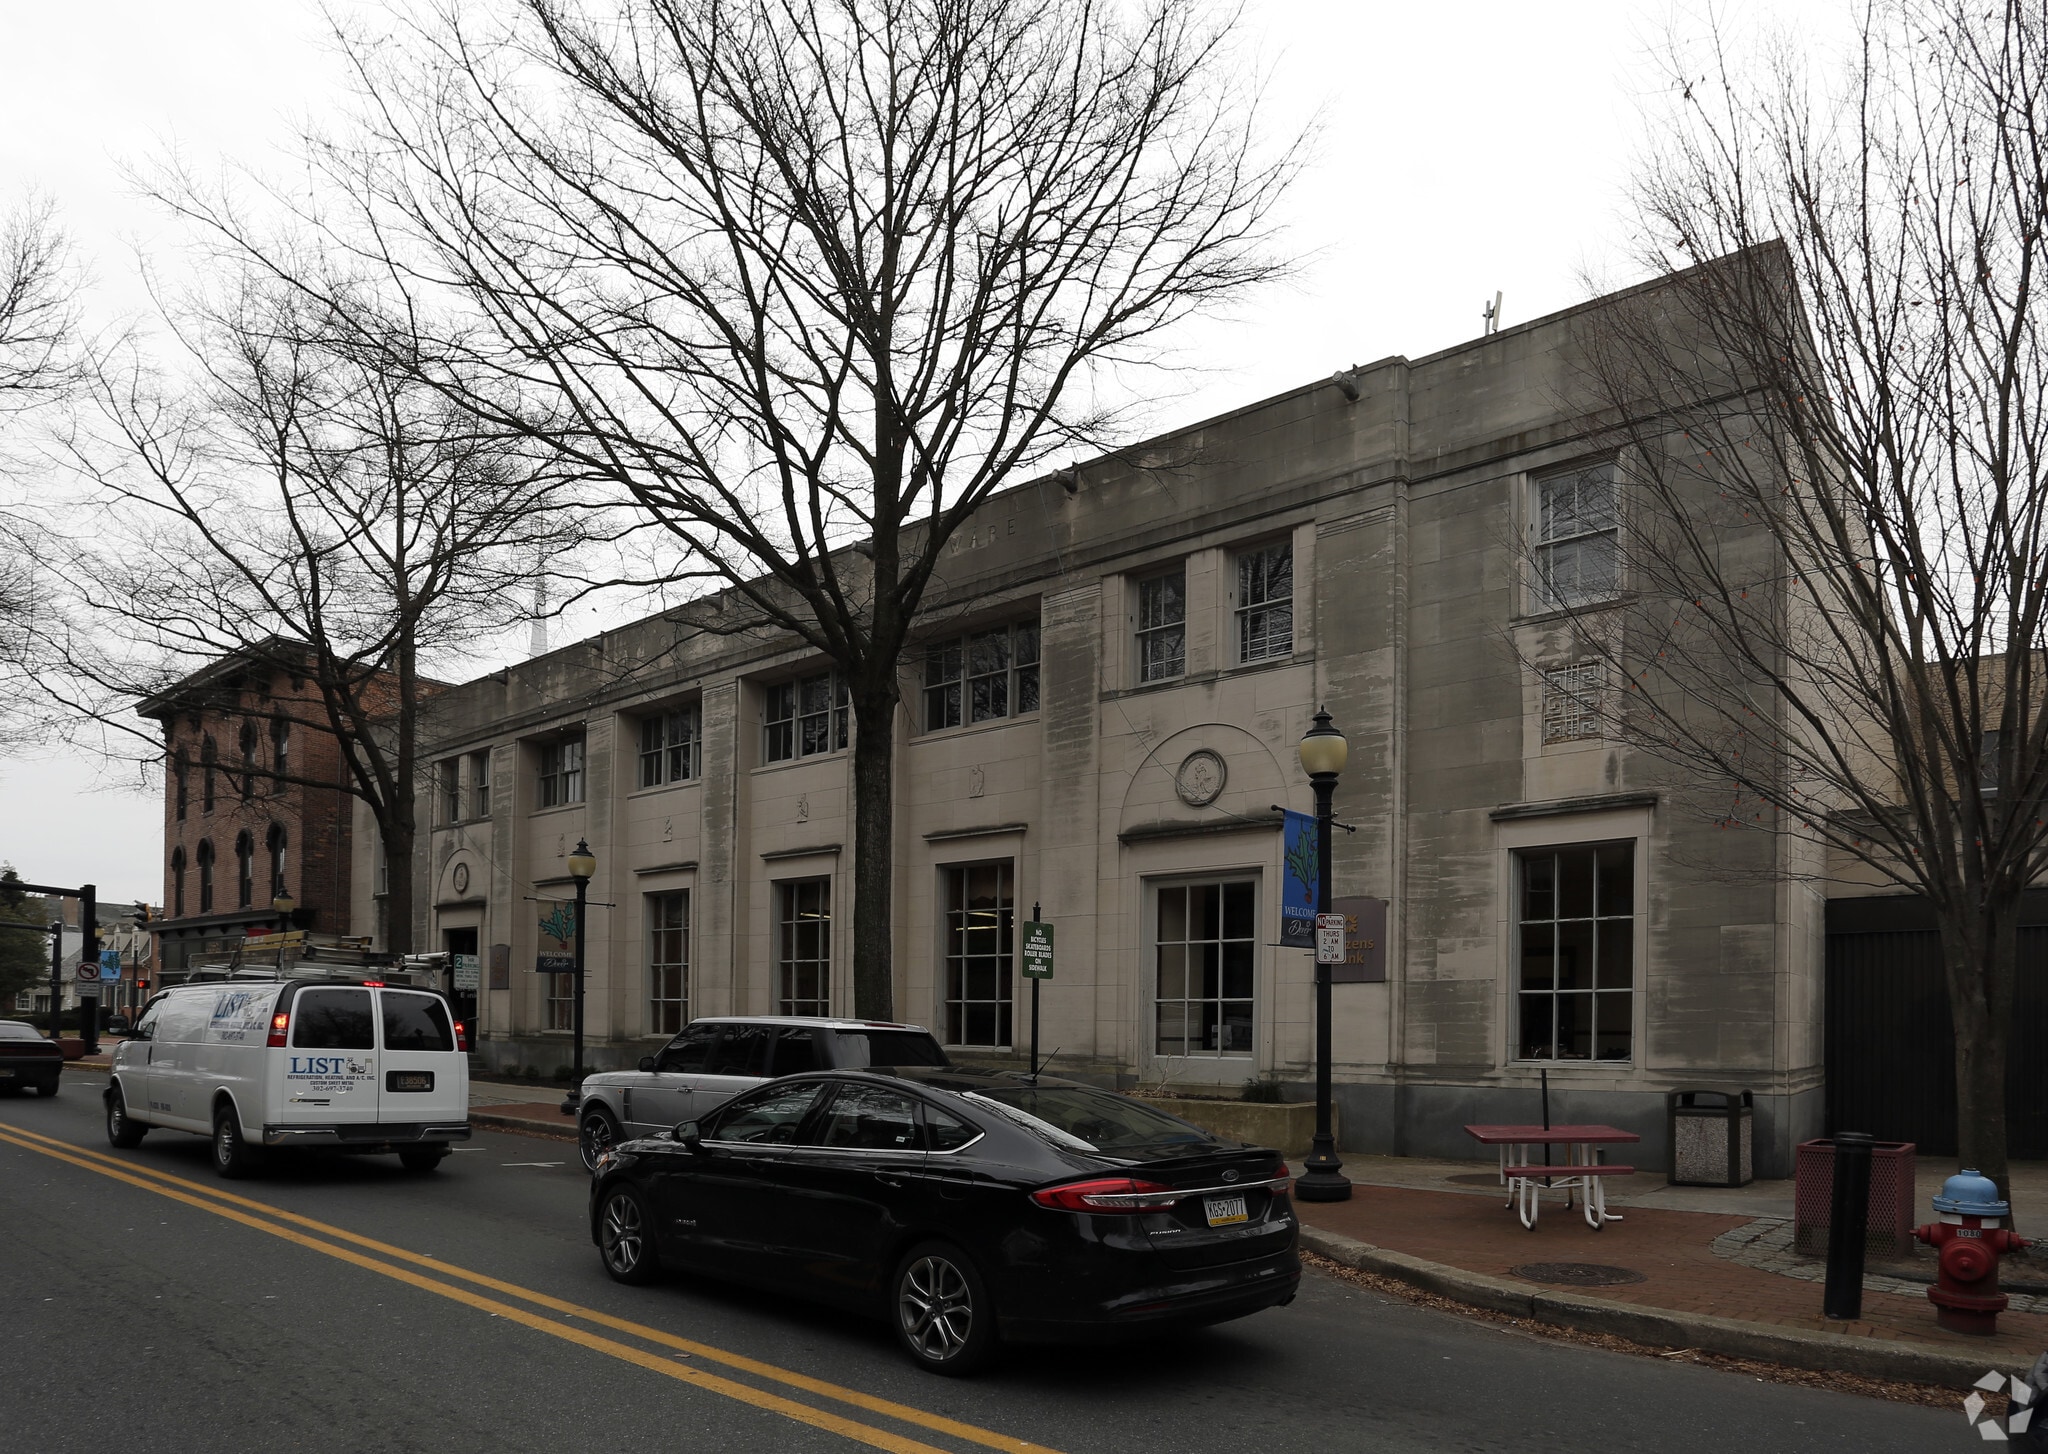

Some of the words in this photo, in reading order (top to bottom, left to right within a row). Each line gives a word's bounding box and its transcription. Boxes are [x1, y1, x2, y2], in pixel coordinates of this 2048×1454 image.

[1284, 905, 1316, 919] WELCOME
[1318, 916, 1326, 927] NO
[1026, 943, 1051, 951] SKATEBOARDS
[1346, 938, 1375, 950] zens
[456, 957, 462, 968] 2
[1347, 951, 1365, 964] nk
[213, 993, 250, 1018] LIST
[289, 1057, 346, 1075] LIST
